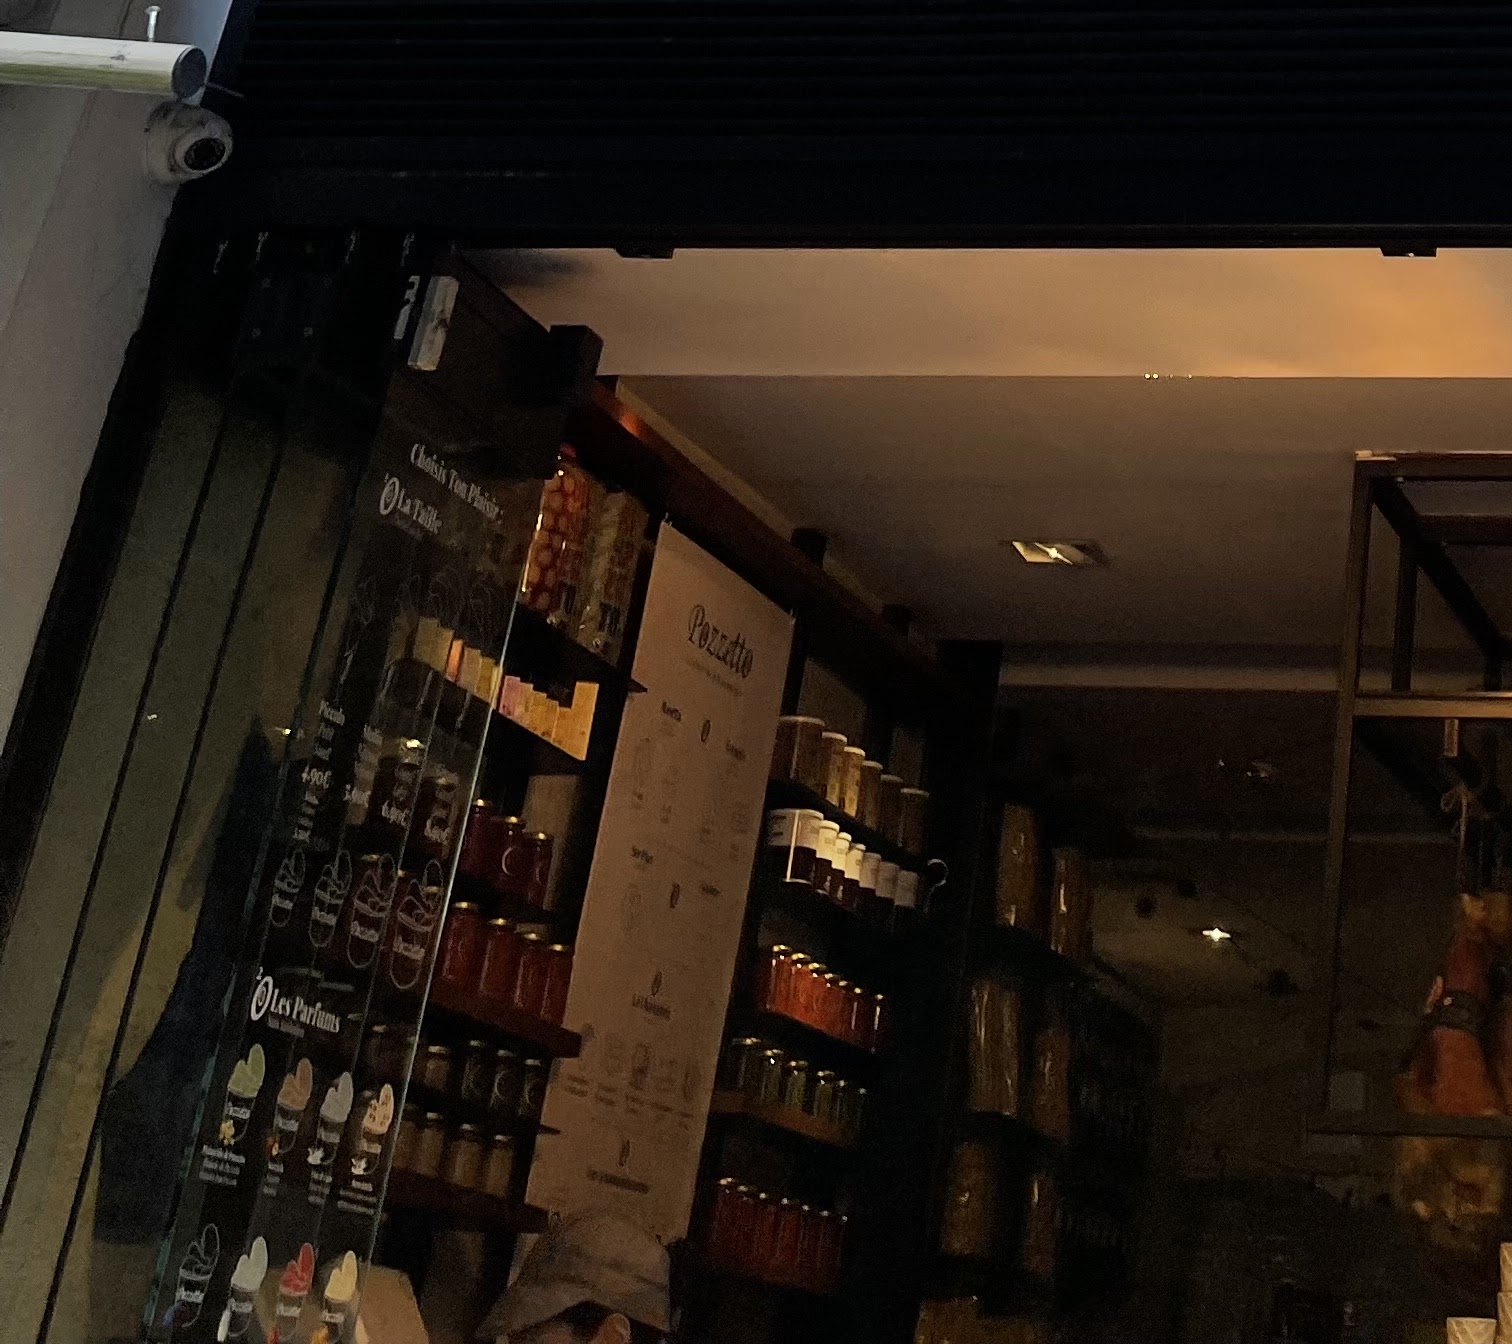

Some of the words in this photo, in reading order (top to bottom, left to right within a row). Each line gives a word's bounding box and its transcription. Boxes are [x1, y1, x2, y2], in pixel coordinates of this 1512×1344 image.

[687, 603, 754, 679] Pozzetto
[269, 988, 291, 1016] Les
[292, 996, 341, 1033] Parfums
